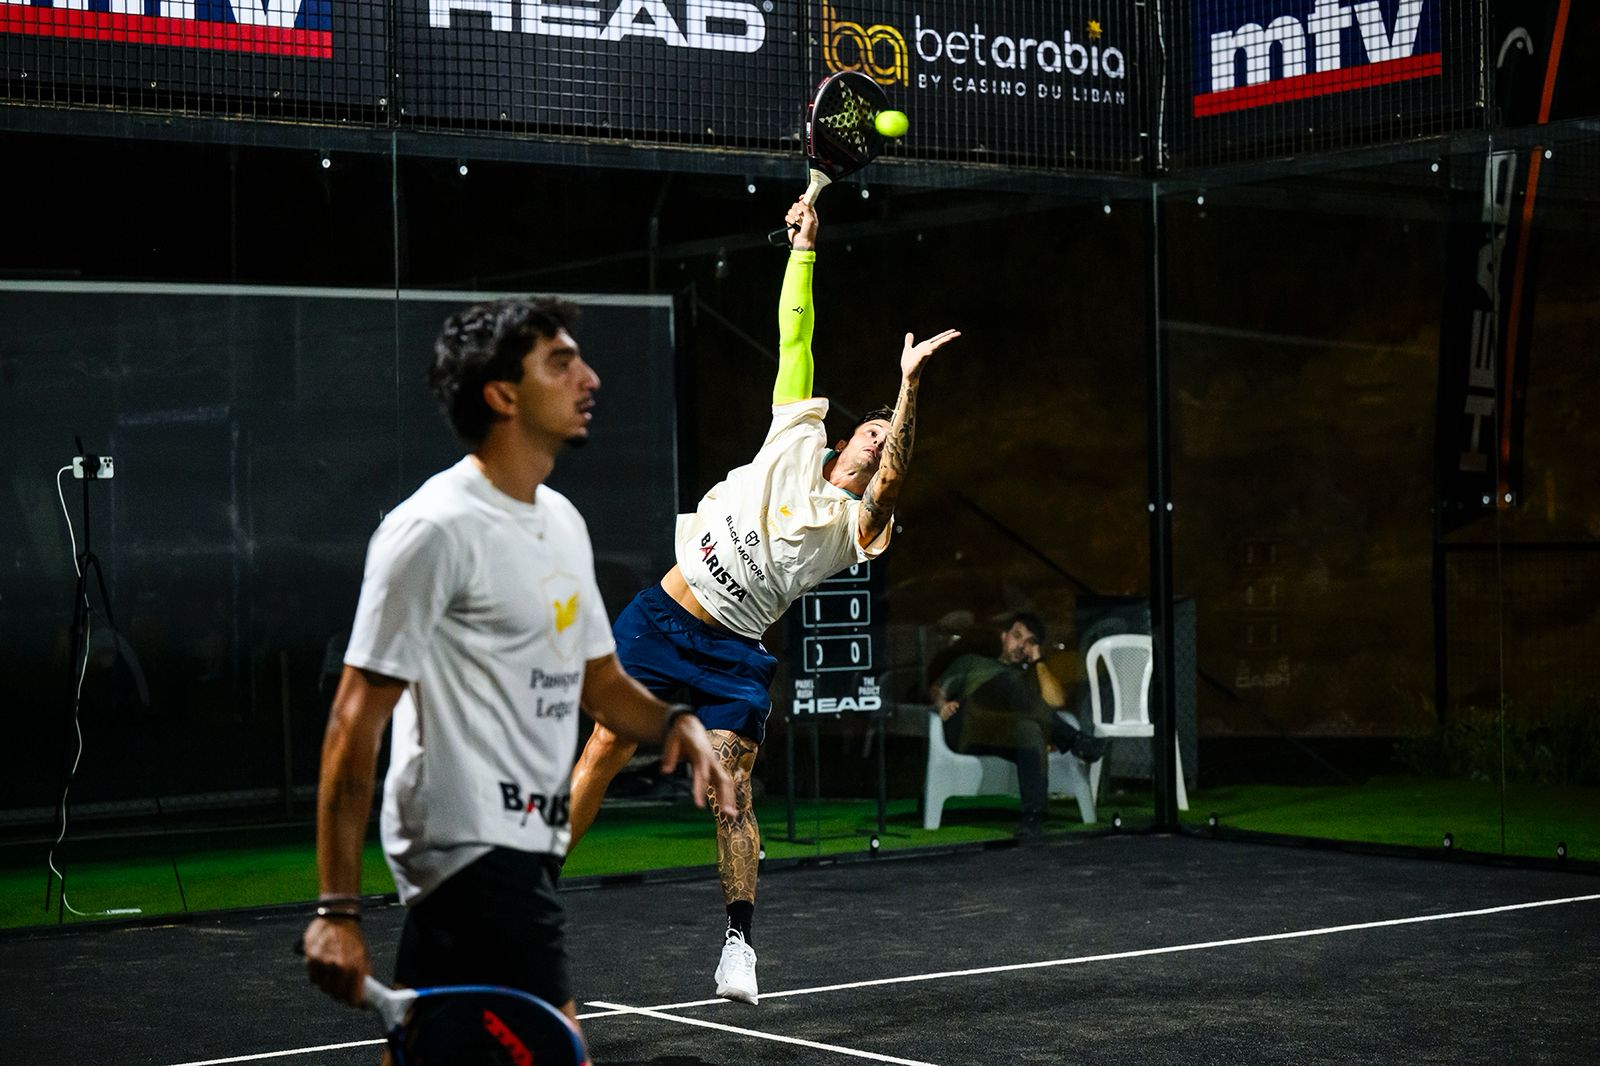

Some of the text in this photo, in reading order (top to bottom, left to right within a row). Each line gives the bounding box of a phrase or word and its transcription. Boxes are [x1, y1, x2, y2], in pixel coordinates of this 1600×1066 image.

[429, 0, 766, 53] HEAD
[1211, 0, 1424, 93] mtv
[918, 73, 1126, 106] BY CASINO DU LIBAN
[699, 531, 749, 603] BARISTA
[736, 545, 766, 581] MOTORS
[850, 597, 860, 620] 0
[850, 641, 860, 664] 0
[793, 696, 882, 714] HEAD
